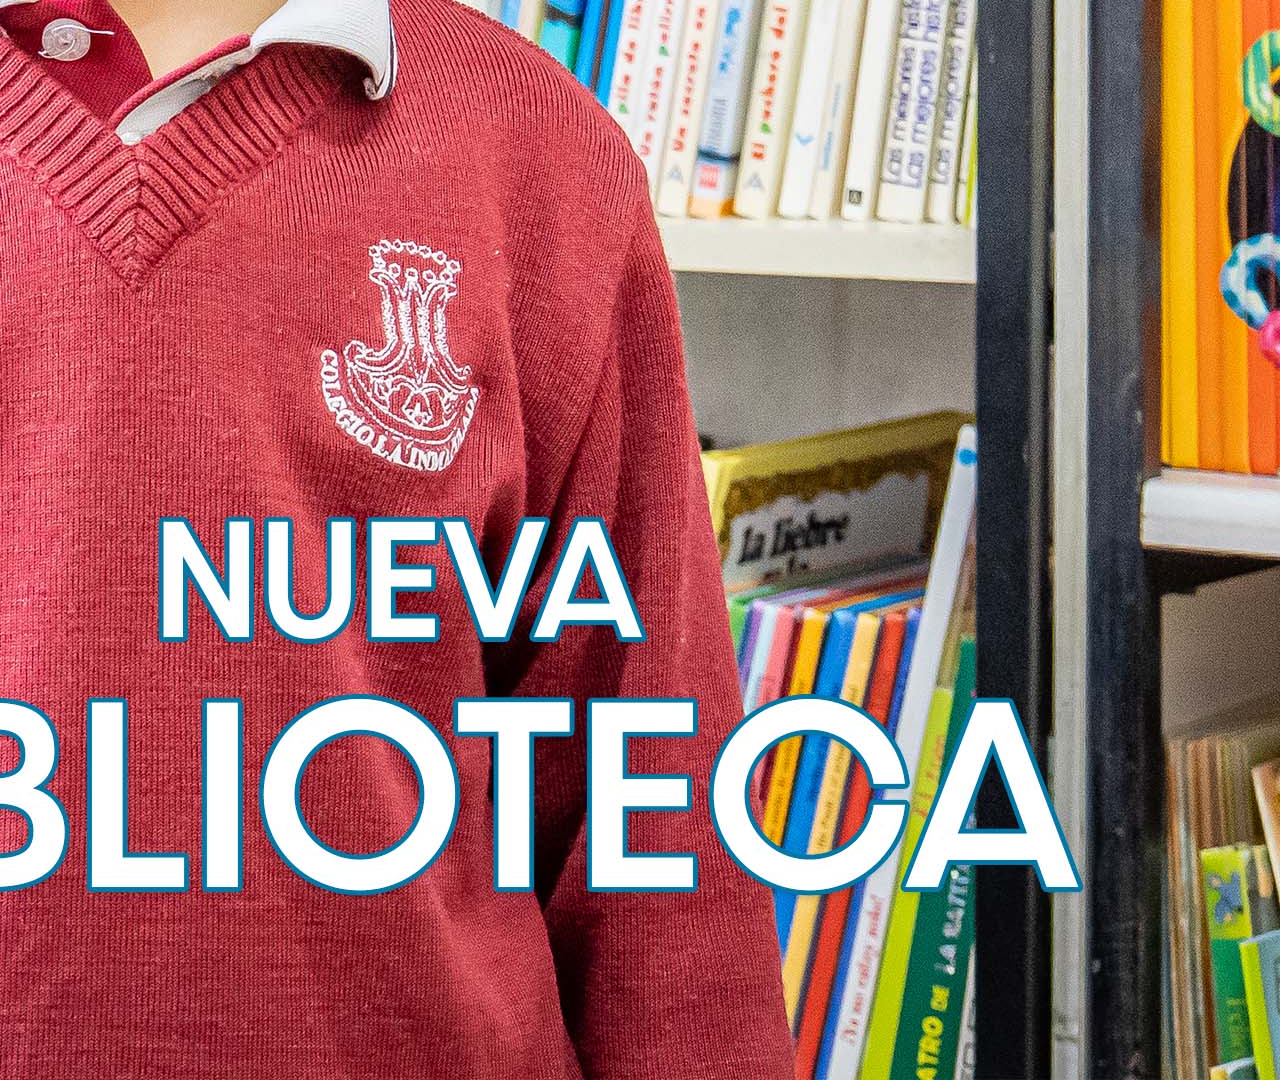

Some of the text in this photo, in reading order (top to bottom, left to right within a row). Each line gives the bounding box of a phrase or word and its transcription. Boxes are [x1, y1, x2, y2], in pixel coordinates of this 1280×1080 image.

[769, 6, 789, 41] del
[622, 38, 638, 66] de
[758, 48, 783, 136] puchero
[890, 45, 916, 142] mejores
[911, 48, 939, 145] mejores
[940, 45, 964, 142] mejores
[669, 125, 688, 154] Un
[750, 140, 768, 162] El
[882, 146, 904, 186] Las
[907, 149, 927, 190] Las
[929, 146, 953, 185] Las
